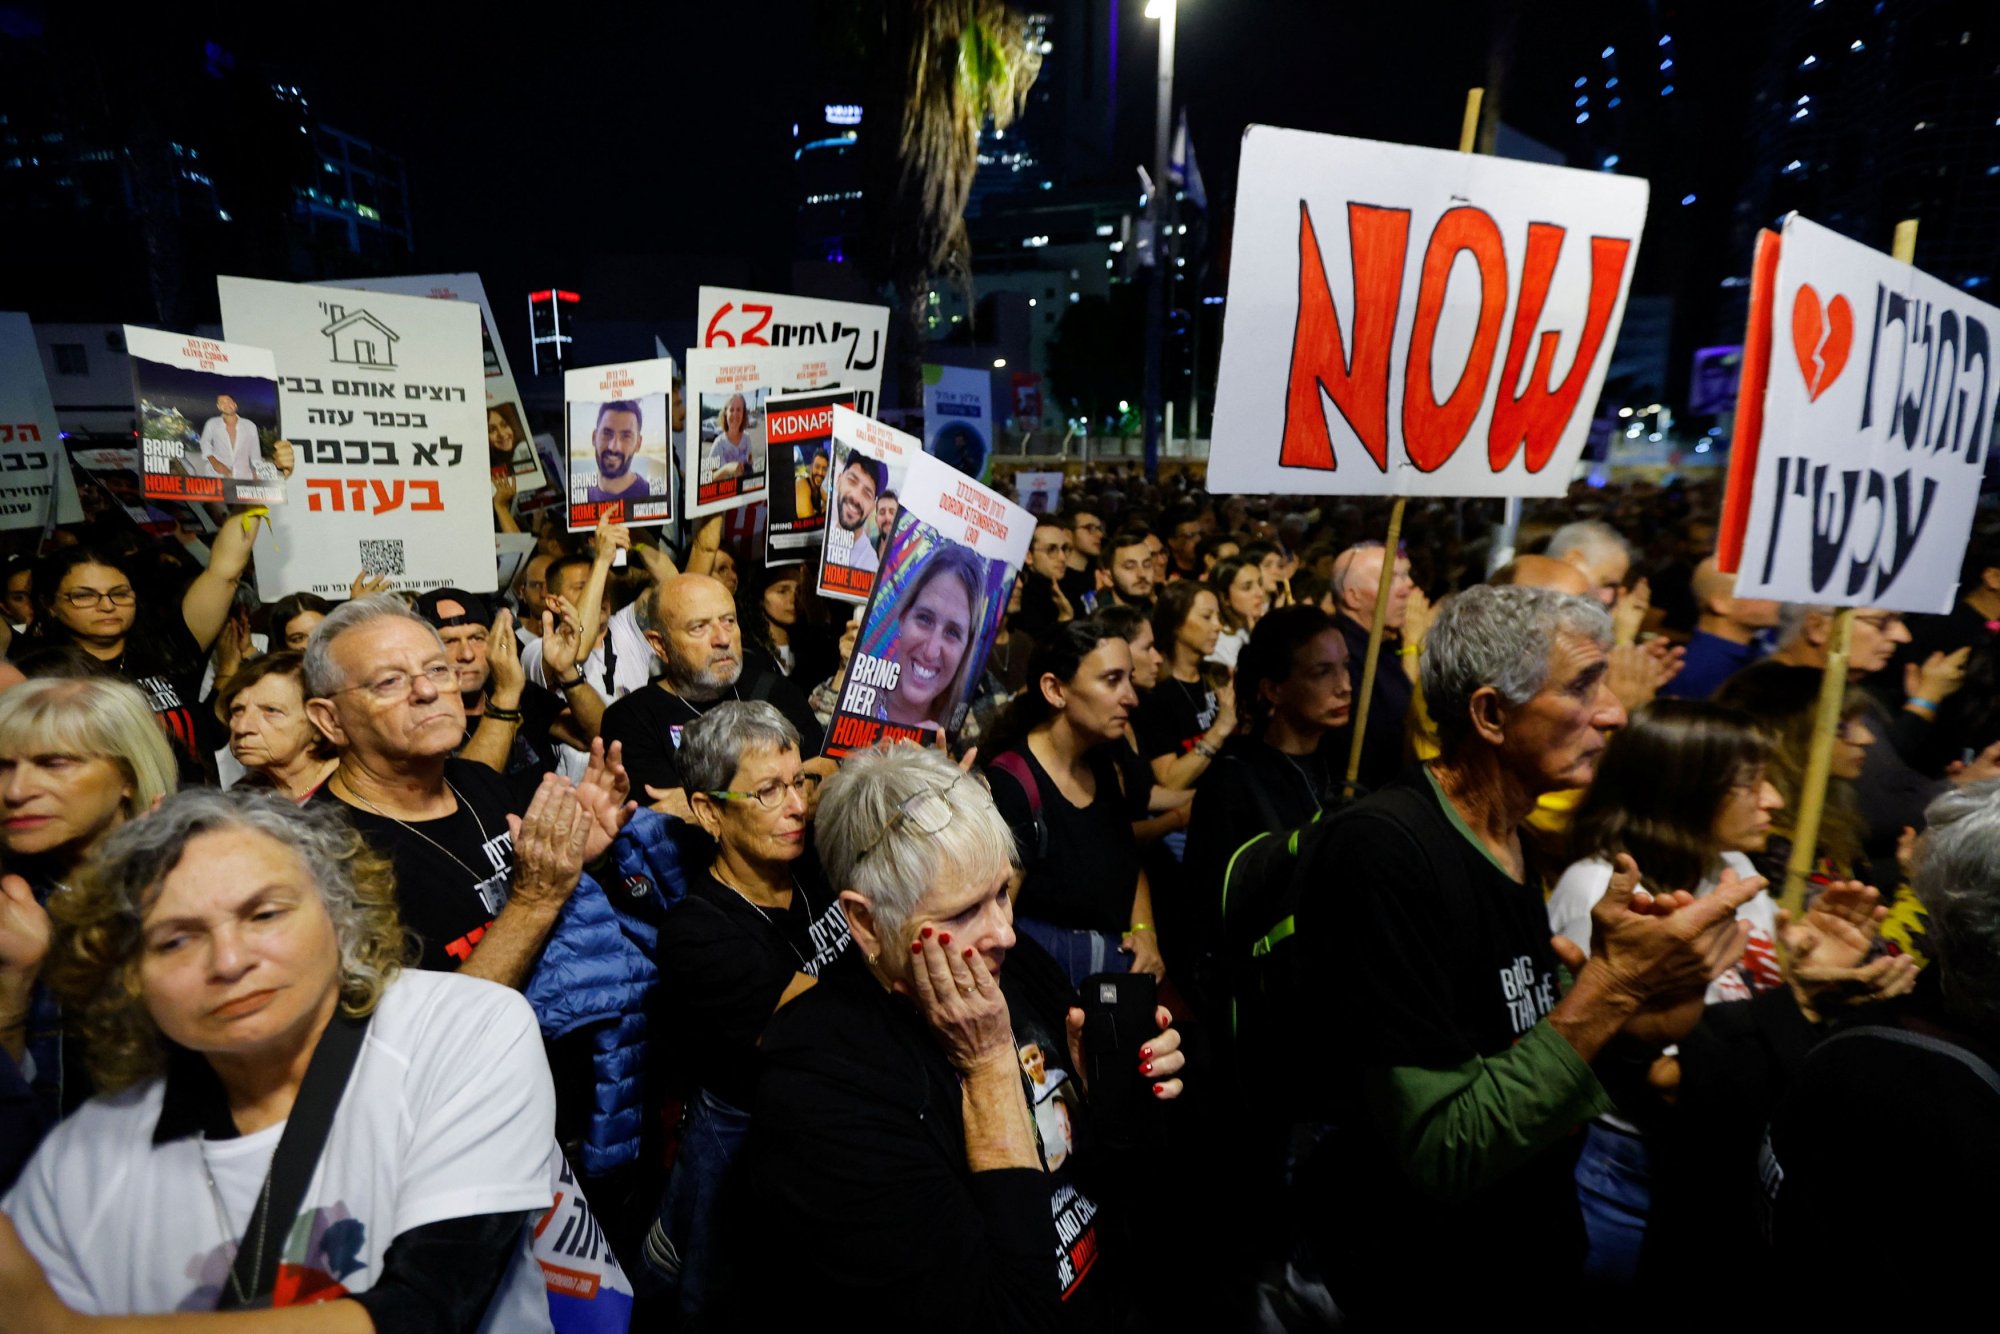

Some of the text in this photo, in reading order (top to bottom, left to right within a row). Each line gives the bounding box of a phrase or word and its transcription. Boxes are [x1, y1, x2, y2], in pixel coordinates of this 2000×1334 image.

[1279, 198, 1632, 473] NOW
[332, 380, 396, 399] אותם
[404, 384, 466, 402] רוצים
[308, 408, 428, 428] בכפר עזה
[143, 437, 185, 459] BRING
[287, 436, 463, 467] לא בכפר
[143, 455, 171, 475] HIM
[700, 455, 721, 471] BRING
[144, 474, 183, 493] HOME
[185, 477, 224, 495] NOW!
[571, 471, 598, 489] BRING
[700, 469, 713, 486] HER
[306, 479, 445, 516] בעזה
[571, 487, 589, 505] HIM
[700, 482, 718, 499] HOME
[571, 502, 597, 521] HOME
[770, 521, 793, 532] BRING
[1761, 456, 1939, 600] עכשיו
[828, 527, 855, 549] BRING
[826, 544, 851, 567] THEM
[823, 563, 849, 587] HOME
[850, 651, 901, 691] BRING
[841, 683, 876, 717] HER
[831, 715, 881, 750] HOME
[1055, 1209, 1081, 1248] AND
